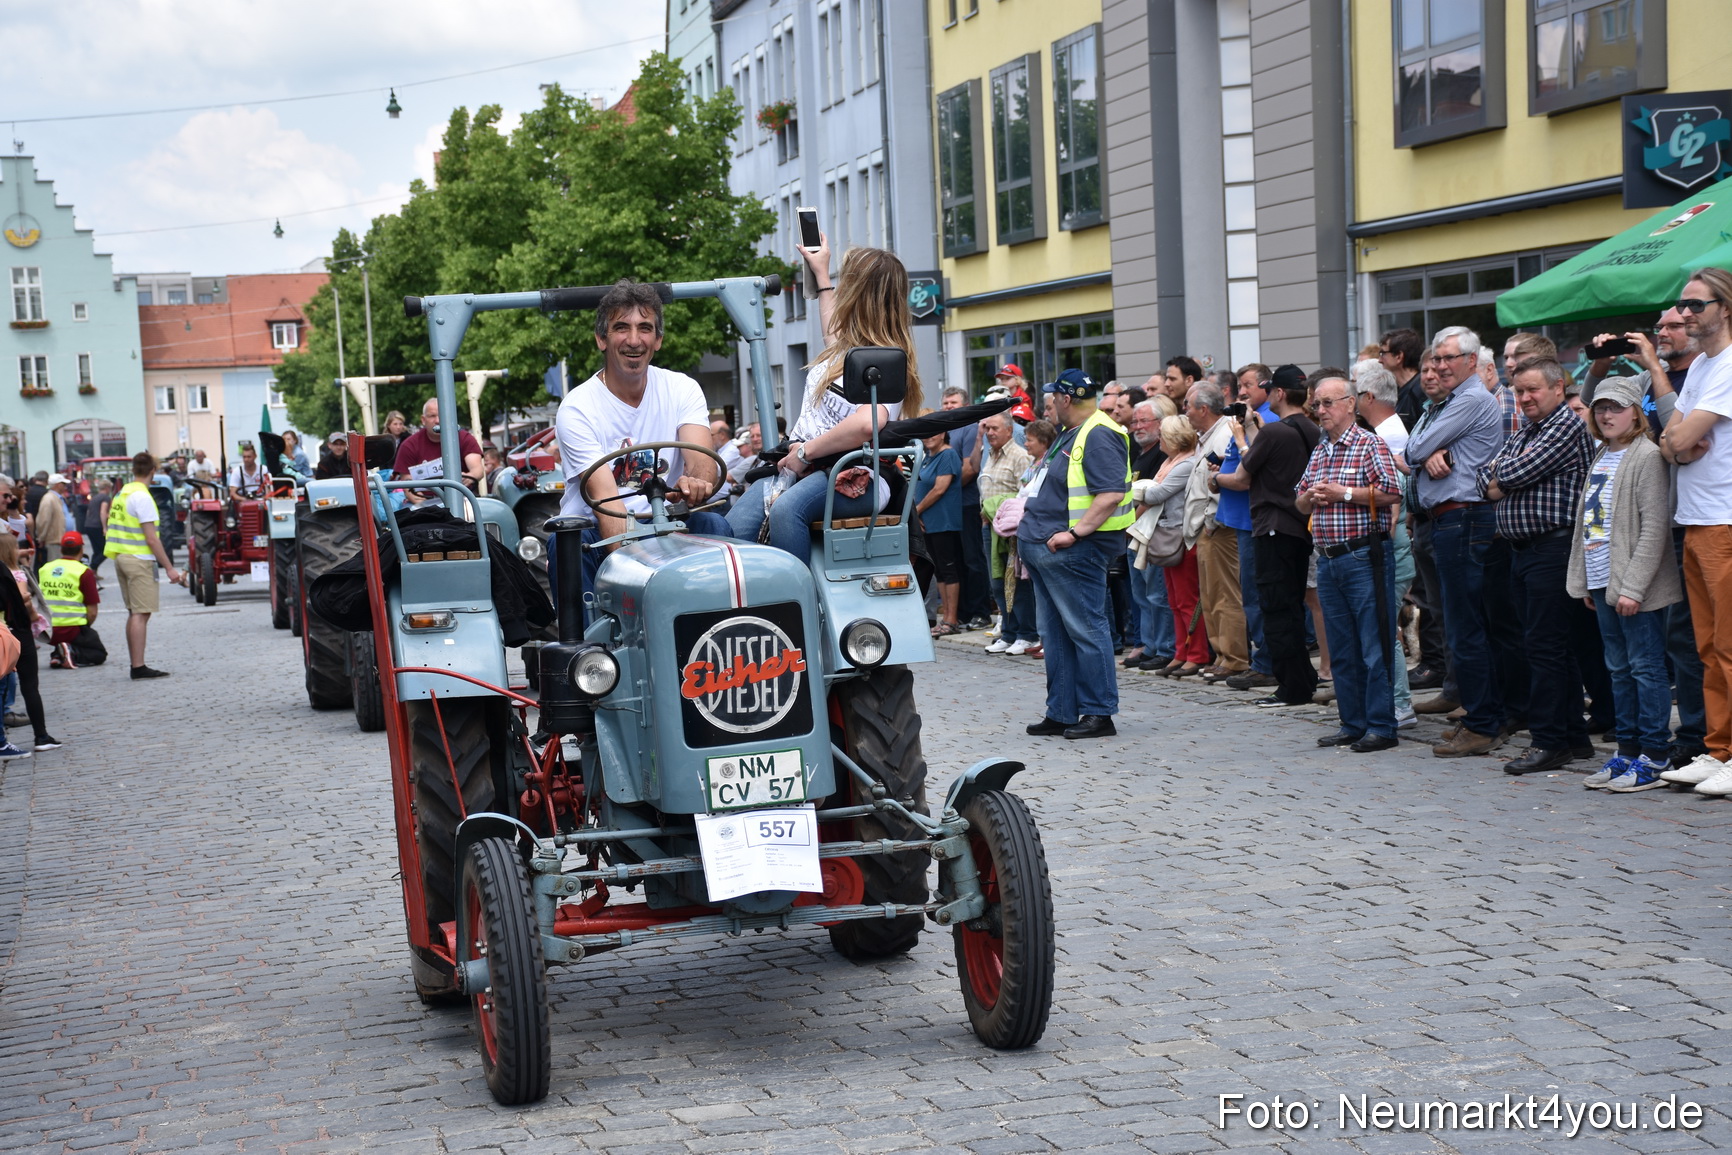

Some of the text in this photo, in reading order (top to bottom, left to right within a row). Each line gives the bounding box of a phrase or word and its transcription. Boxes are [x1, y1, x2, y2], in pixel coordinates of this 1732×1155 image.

[1669, 123, 1706, 168] G2
[910, 285, 928, 309] G2
[43, 581, 73, 590] OLLOW
[47, 589, 59, 597] ME
[681, 648, 806, 699] Eicher
[739, 755, 775, 779] NM
[719, 776, 796, 804] CV 57
[759, 820, 796, 838] 557
